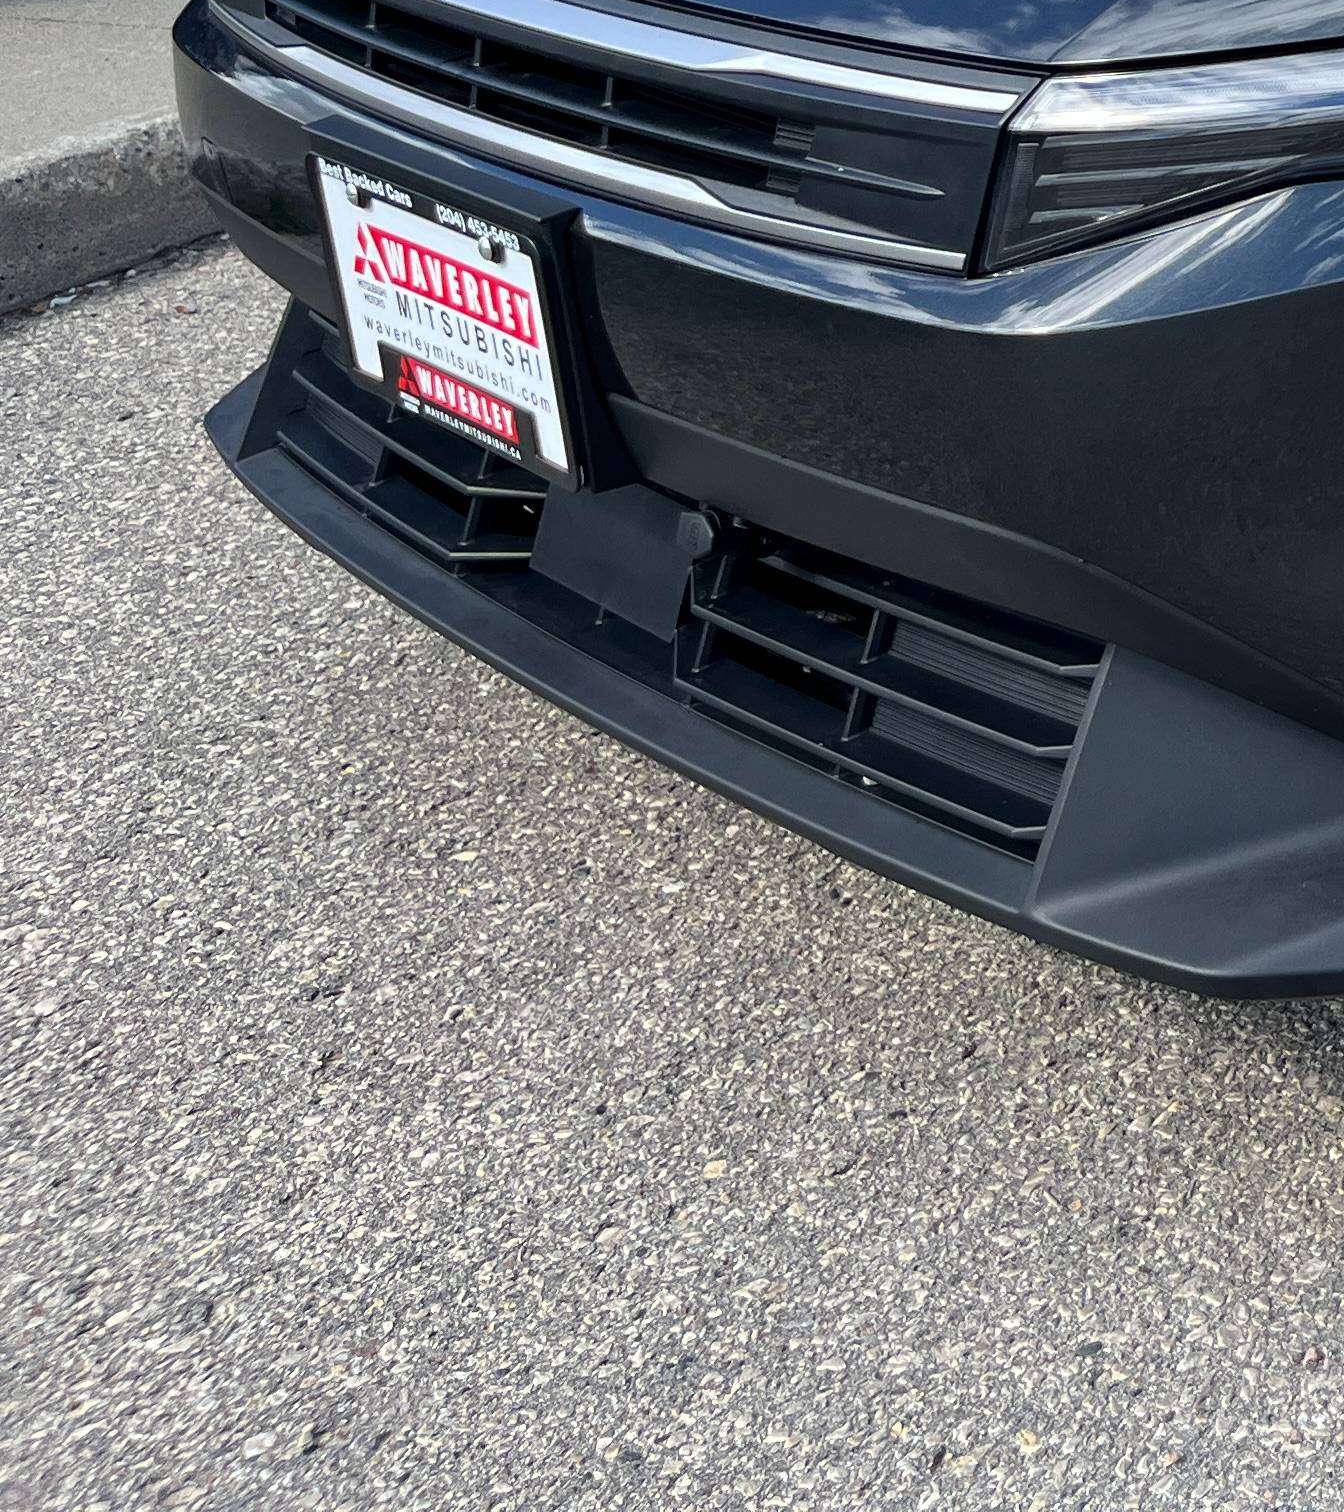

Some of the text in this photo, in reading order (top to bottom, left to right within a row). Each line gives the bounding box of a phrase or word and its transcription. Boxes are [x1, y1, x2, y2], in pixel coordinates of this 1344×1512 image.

[343, 166, 386, 197] Backed
[385, 183, 413, 208] Cars
[434, 203, 520, 251] (204) 453-5453
[380, 237, 532, 338] WAVERLEY
[364, 313, 552, 415] waverleymitsubishi.com
[396, 290, 544, 382] MITSUBISHI
[416, 365, 514, 437] WAVERLEY
